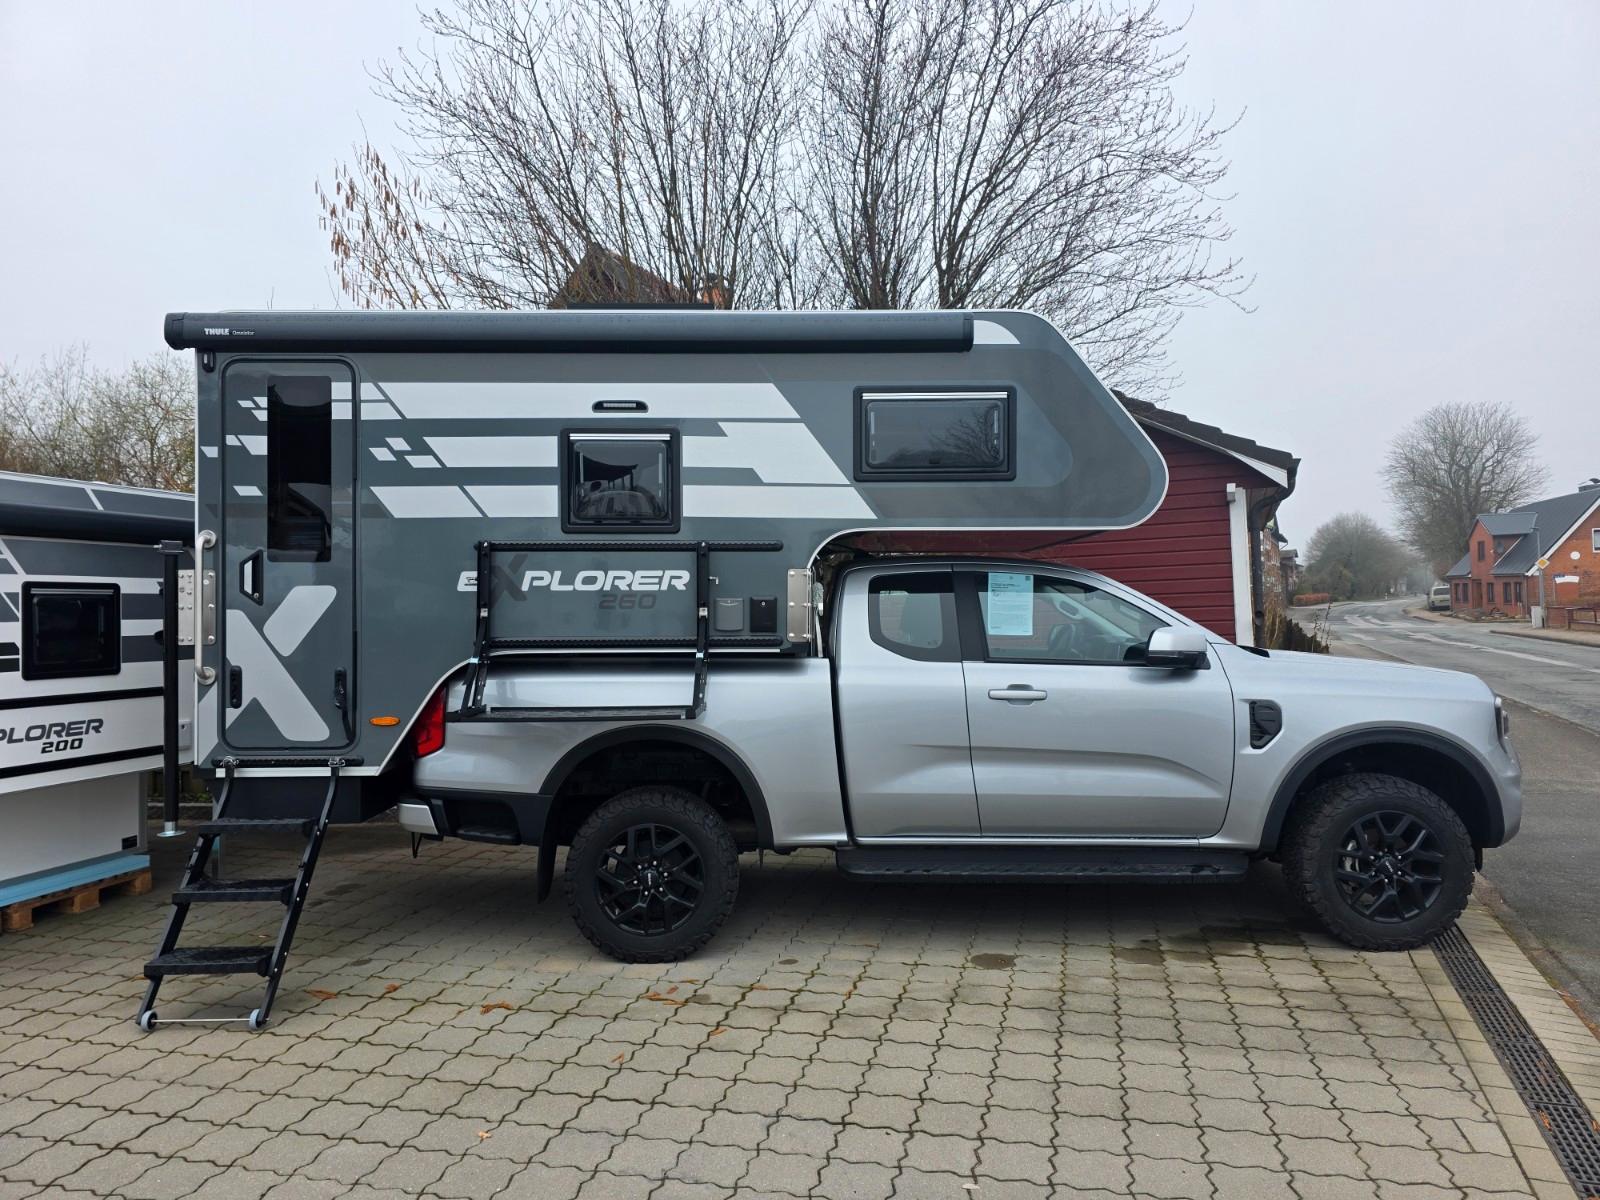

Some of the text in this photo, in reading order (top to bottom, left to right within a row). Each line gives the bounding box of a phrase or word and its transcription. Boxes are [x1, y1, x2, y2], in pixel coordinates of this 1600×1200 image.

[204, 327, 230, 336] THULE
[599, 593, 657, 609] 260
[41, 738, 83, 754] 200
